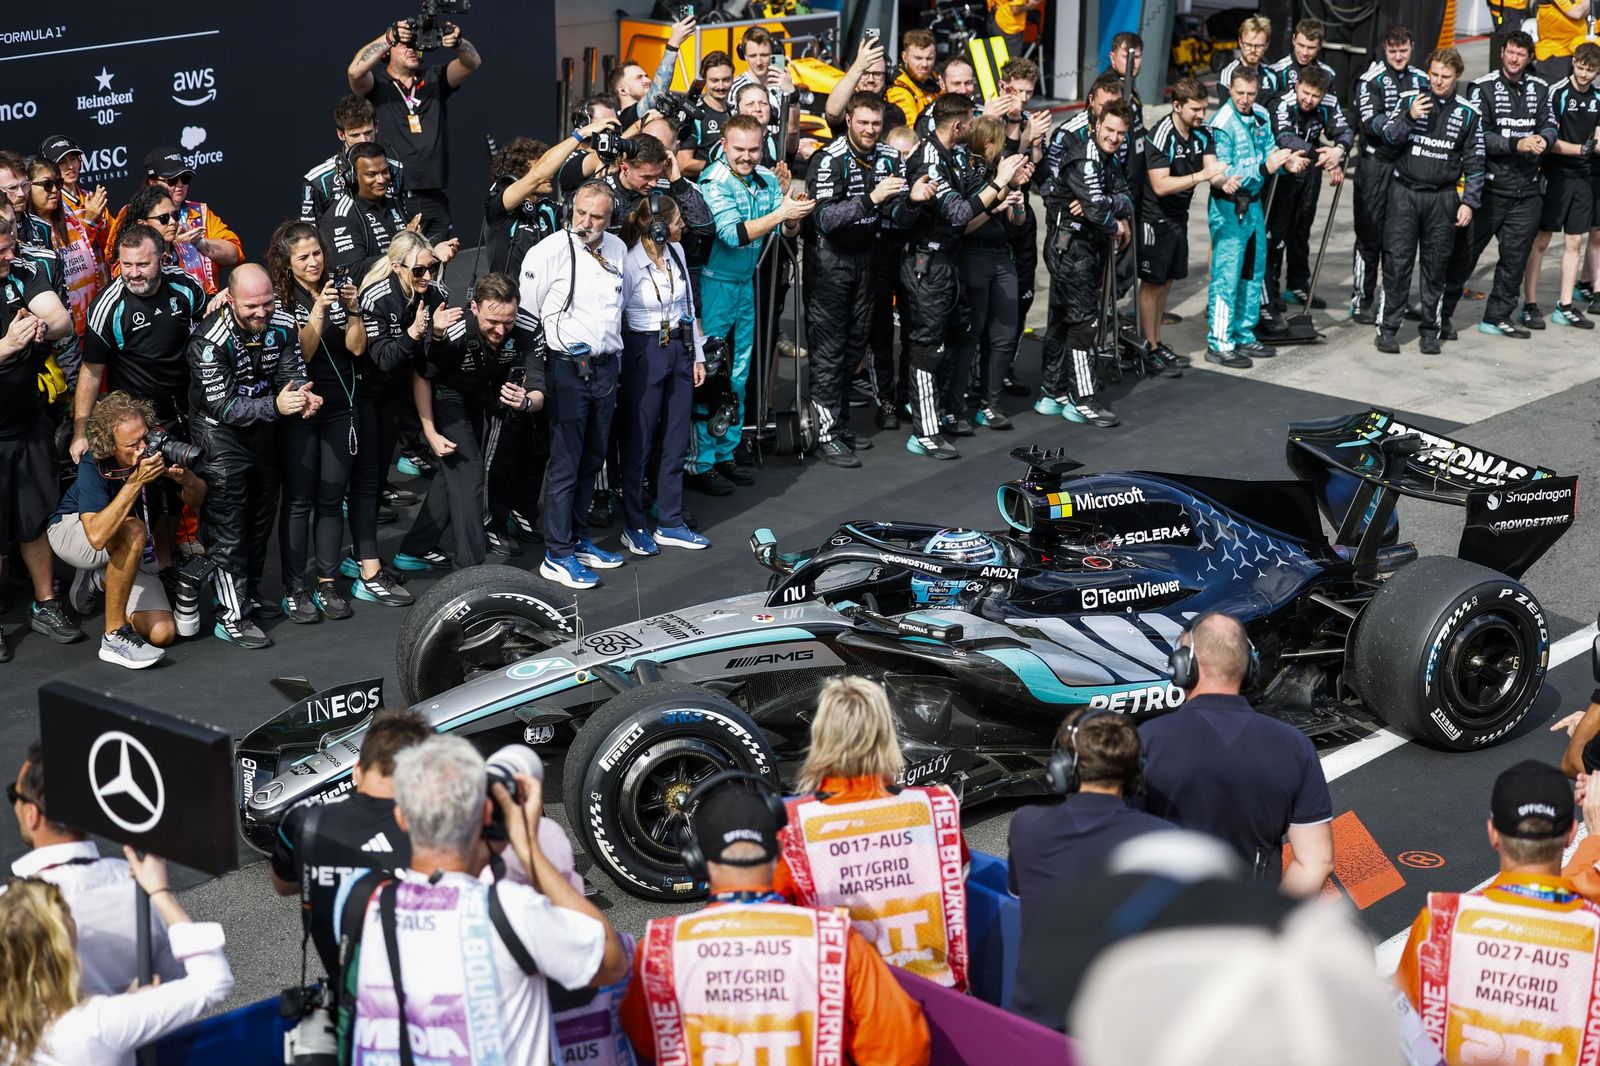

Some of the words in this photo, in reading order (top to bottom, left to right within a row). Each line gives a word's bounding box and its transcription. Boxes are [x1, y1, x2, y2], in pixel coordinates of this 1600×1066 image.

[173, 67, 215, 92] aws
[1408, 133, 1456, 149] PETRONAS
[80, 146, 128, 174] MSC
[183, 150, 223, 170] esforce
[79, 170, 129, 184] CRUISES
[65, 264, 88, 277] ARSHAL
[1074, 486, 1146, 511] Microsoft
[1505, 487, 1572, 504] Snapdragon
[1493, 514, 1570, 532] CROWDSTRIKE
[1124, 526, 1182, 546] SOLERA
[883, 553, 944, 574] CROWDSTRIKE
[980, 566, 1010, 579] AMD
[1099, 579, 1181, 605] TeamViewer
[1498, 588, 1513, 599] P
[1515, 592, 1549, 643] ZERO
[899, 622, 928, 634] PETRONAS
[753, 649, 814, 666] AMG
[306, 687, 380, 724] INEOS
[1088, 683, 1186, 714] PETRO
[525, 724, 554, 744] FIA
[1430, 707, 1464, 742] PIRELLI
[598, 722, 645, 773] PIRELLI
[898, 752, 952, 786] ignify
[1517, 803, 1556, 817] OFFICIAL
[829, 831, 914, 856] 0017-AUS
[840, 857, 909, 880] PIT/GRID
[839, 875, 915, 896] MARSHAL
[697, 939, 792, 958] 0023-AUS
[1476, 941, 1570, 968] 0027-AUS
[706, 969, 785, 985] PIT/GRID
[1480, 969, 1558, 994] PIT/GRID
[705, 987, 789, 1003] MARSHAL
[1475, 985, 1559, 1013] MARSHAL
